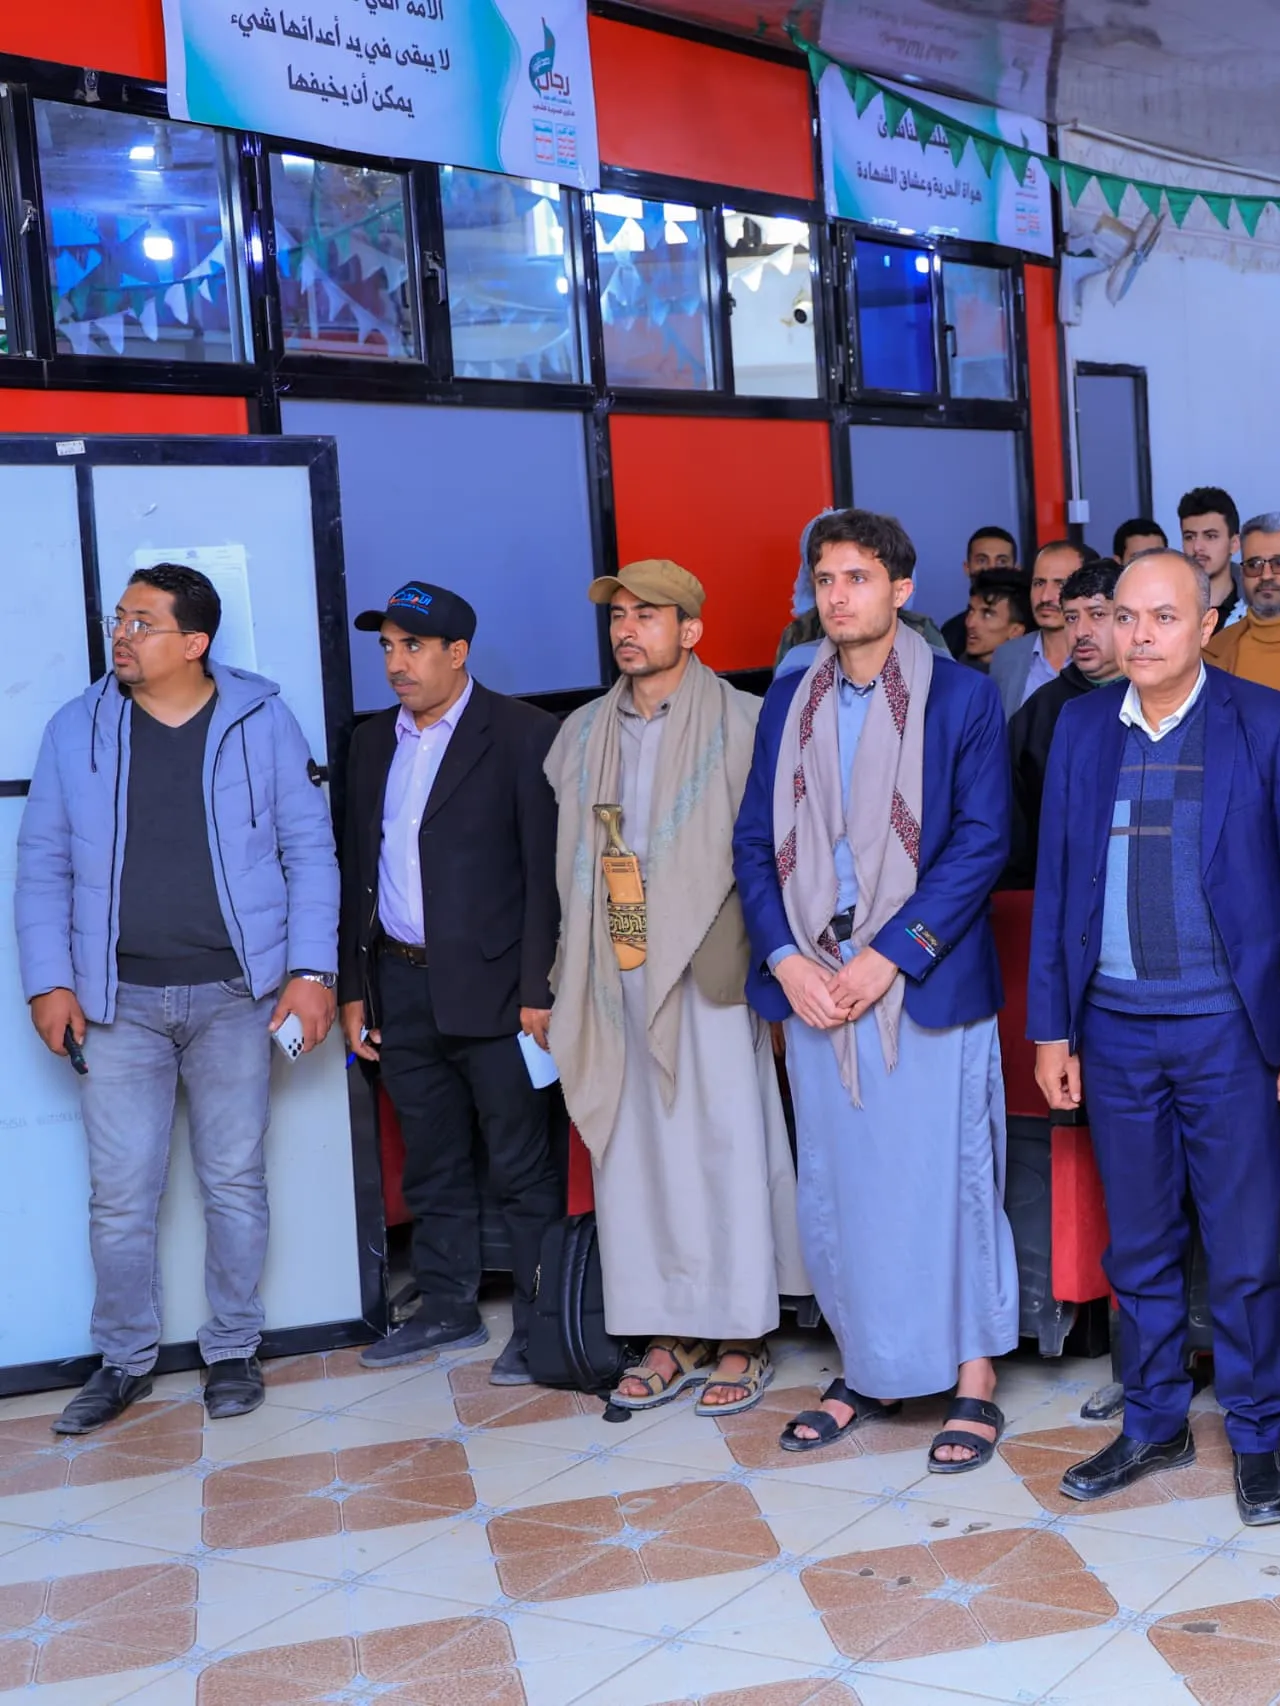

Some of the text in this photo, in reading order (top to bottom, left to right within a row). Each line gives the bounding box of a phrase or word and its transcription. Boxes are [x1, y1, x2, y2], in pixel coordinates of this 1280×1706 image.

[231, 8, 450, 74] لا يبقى في يد أعدائها شيء
[288, 64, 415, 118] يمكن أن يخيفها
[856, 160, 897, 184] الشهادة
[899, 169, 932, 197] وعشاق
[932, 177, 961, 200] الحرية
